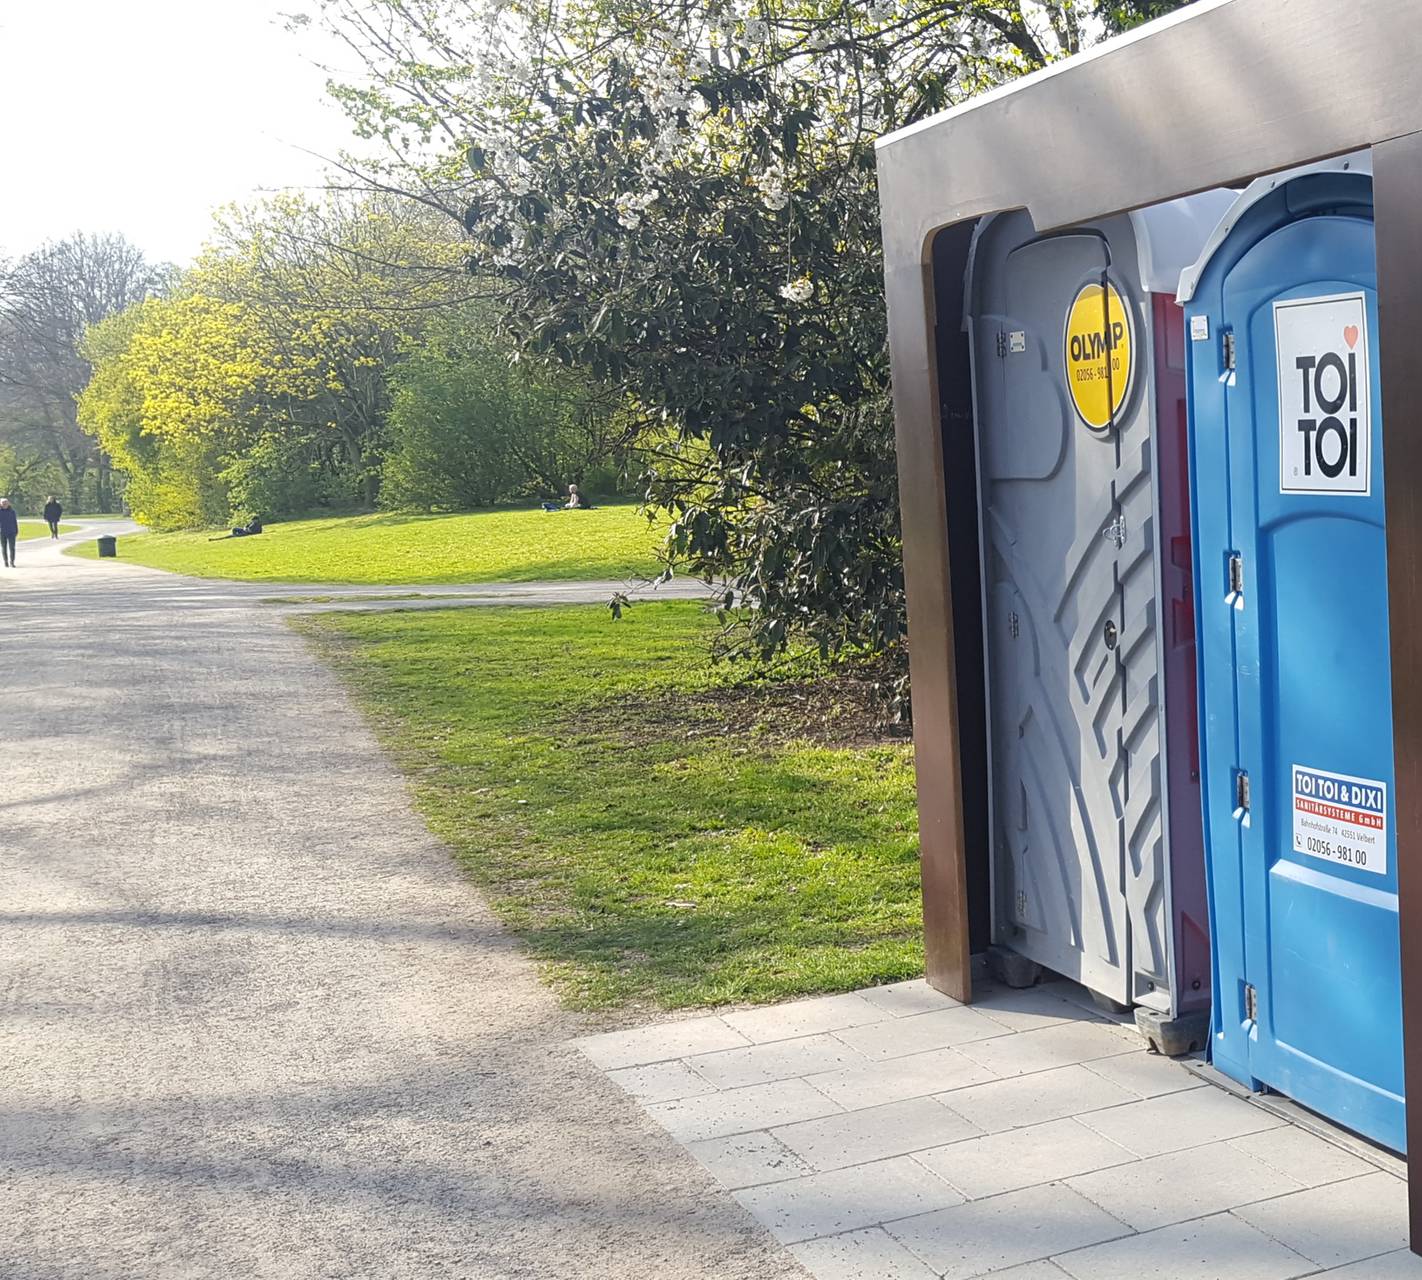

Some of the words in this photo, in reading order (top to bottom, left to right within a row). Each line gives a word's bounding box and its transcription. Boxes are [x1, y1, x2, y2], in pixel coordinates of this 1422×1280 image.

[1071, 322, 1123, 362] OLYMP
[1296, 352, 1357, 414] TOI
[1298, 416, 1357, 478] TOI
[1296, 774, 1316, 795] TOI
[1317, 779, 1339, 800] TOI
[1340, 785, 1350, 802] &
[1351, 786, 1382, 810] DIXI
[1296, 799, 1356, 822] SANITÄRSYSTEME
[1358, 814, 1382, 828] GmbH
[1307, 836, 1331, 856] 02056
[1337, 845, 1353, 862] 981
[1355, 849, 1367, 866] 00
[1356, 832, 1376, 844] Velbert
